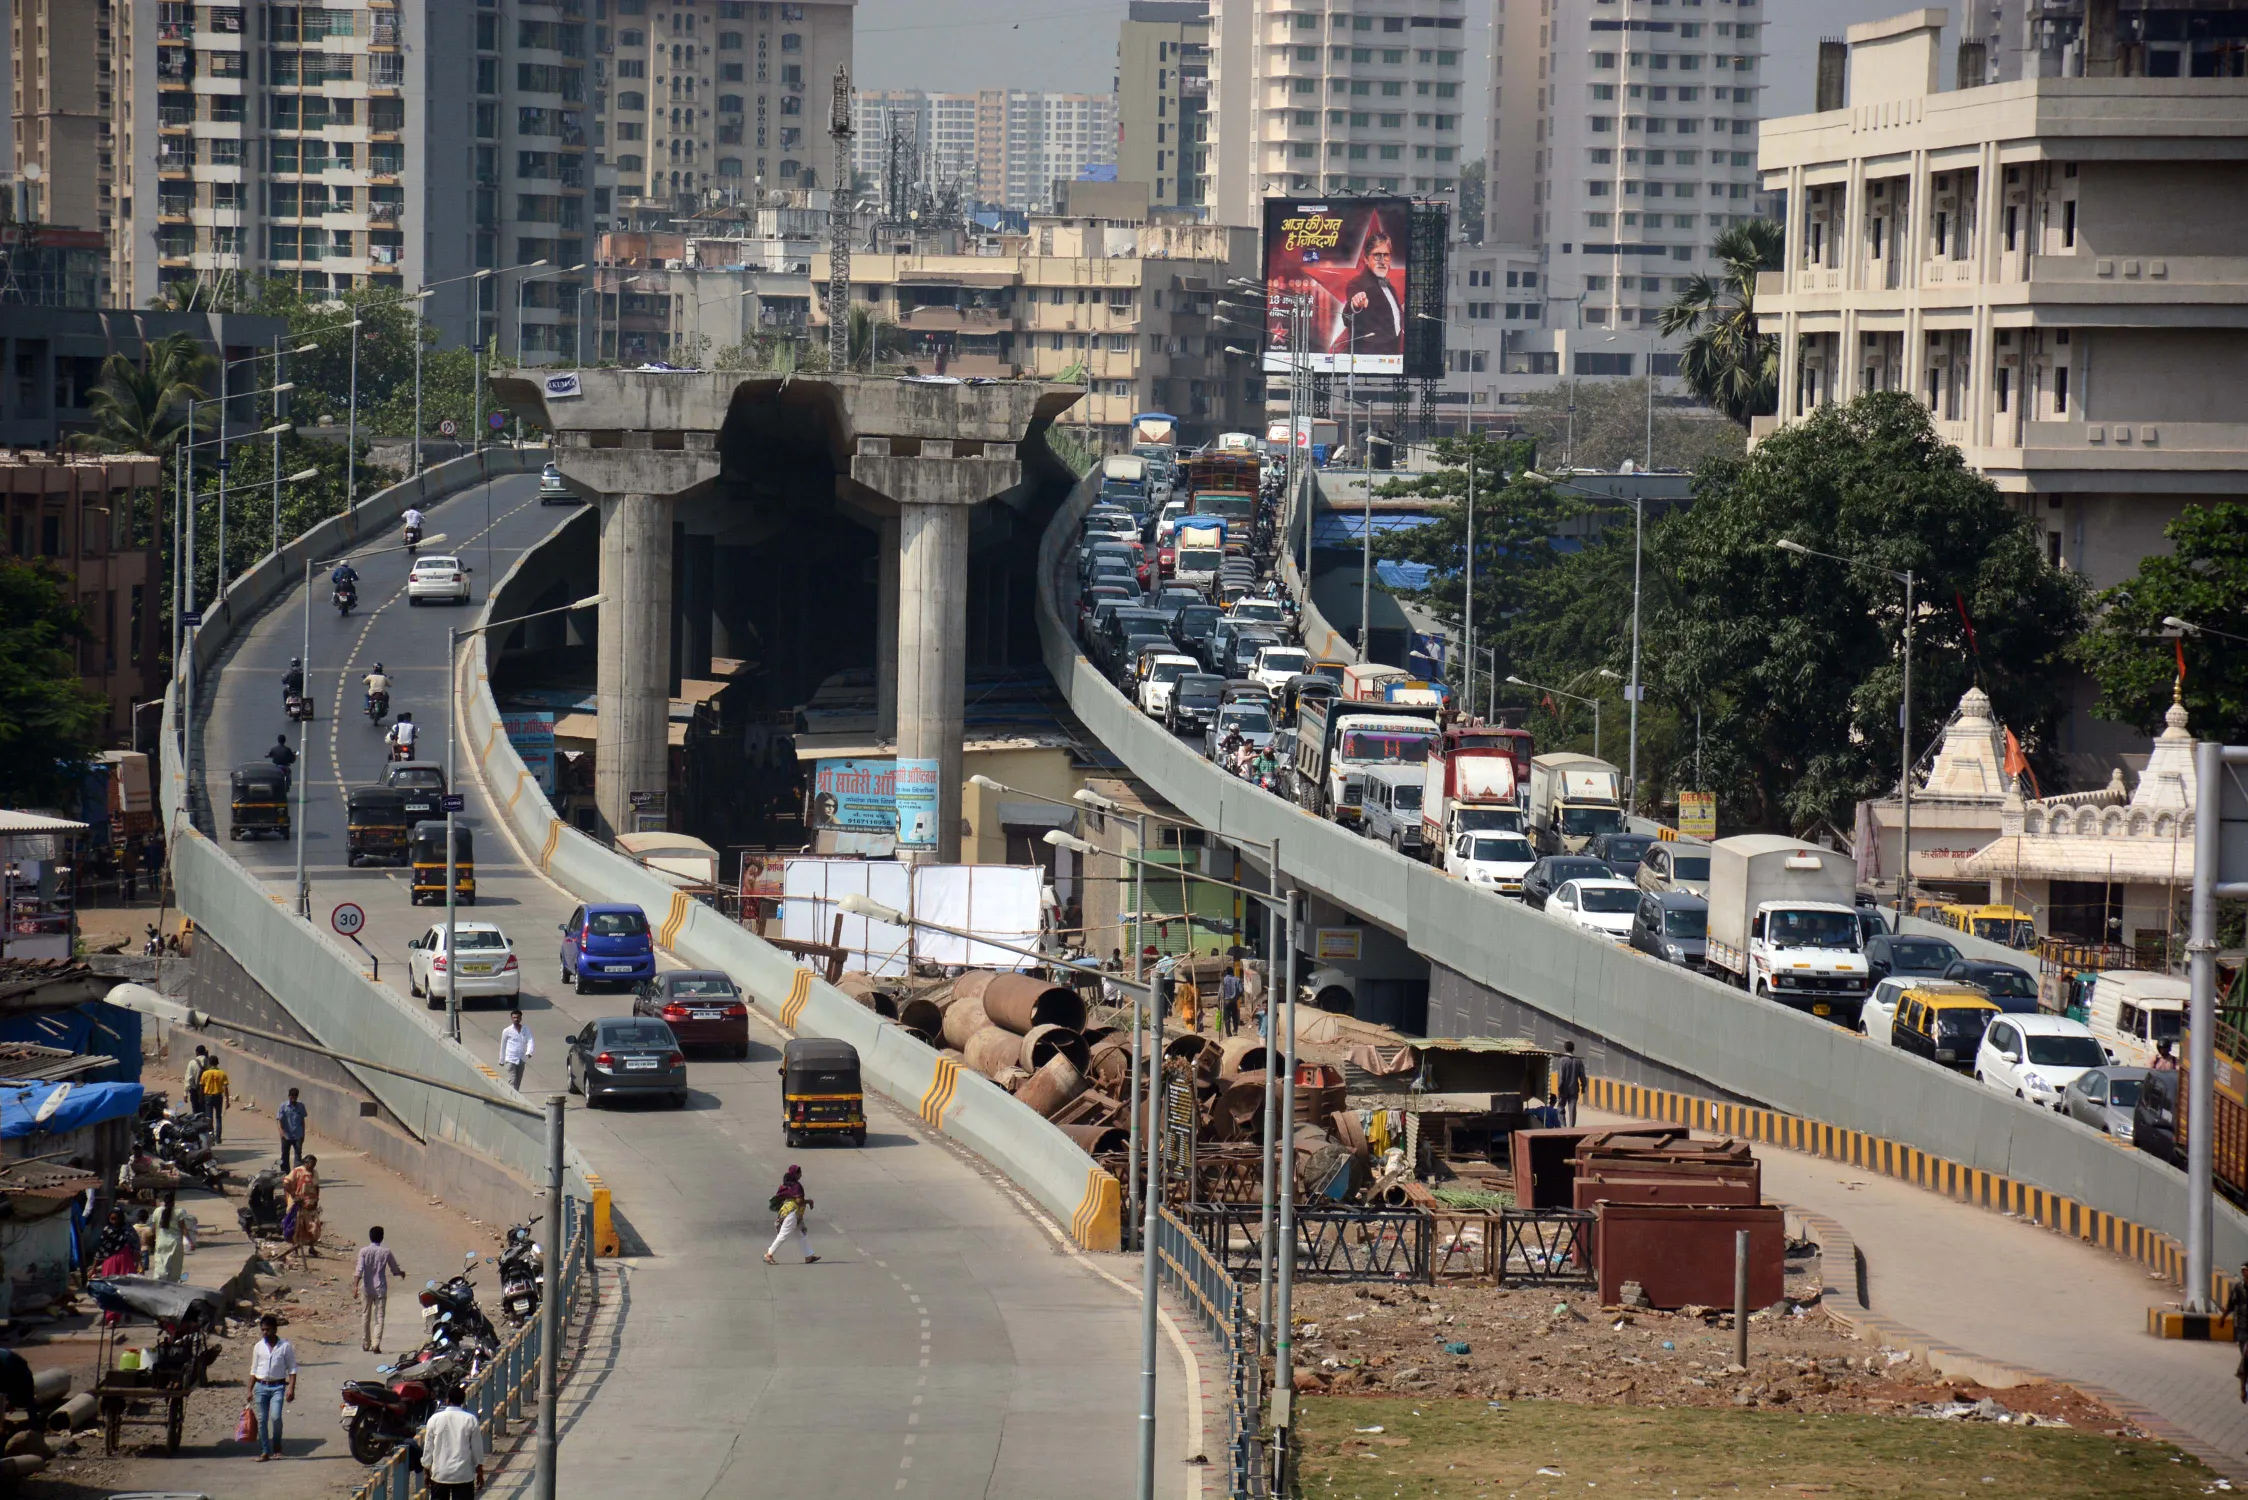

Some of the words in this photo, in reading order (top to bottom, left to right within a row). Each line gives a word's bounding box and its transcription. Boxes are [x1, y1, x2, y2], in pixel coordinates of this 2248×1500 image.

[1281, 218, 1306, 231] आज
[1305, 214, 1321, 230] की
[1323, 218, 1343, 231] रात
[1285, 232, 1297, 251] है
[817, 766, 833, 792] श्री
[340, 914, 358, 926] 30
